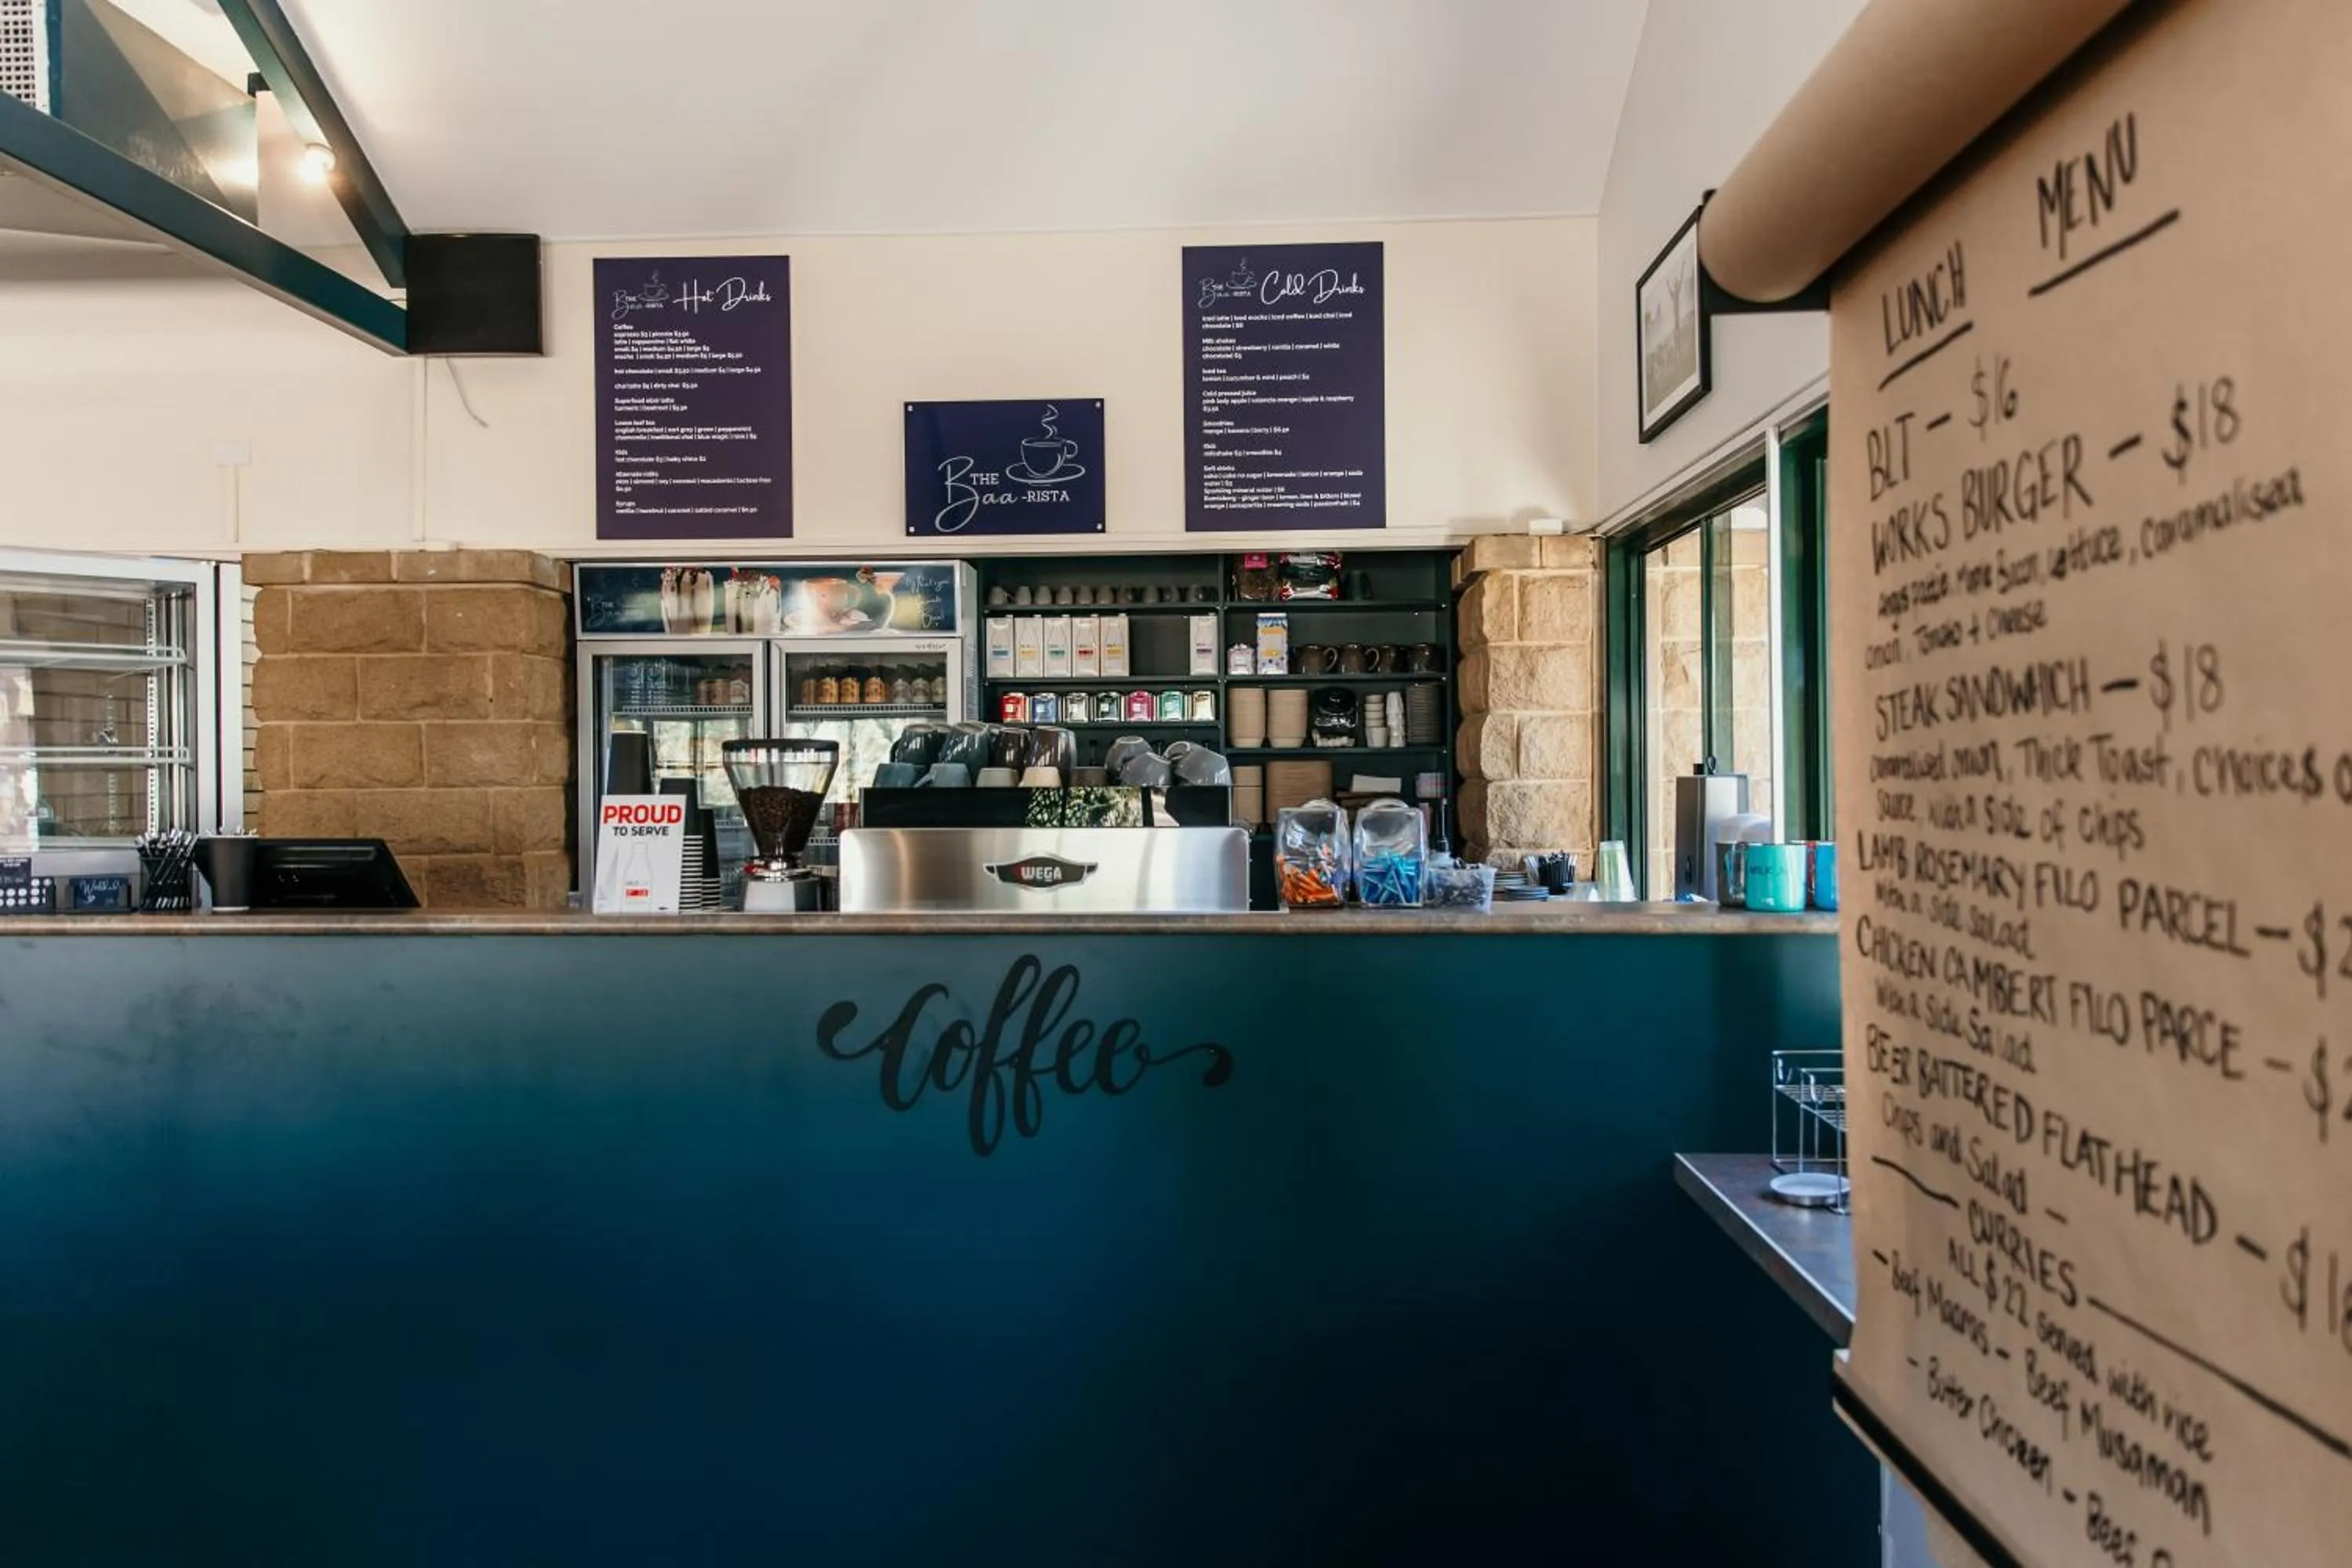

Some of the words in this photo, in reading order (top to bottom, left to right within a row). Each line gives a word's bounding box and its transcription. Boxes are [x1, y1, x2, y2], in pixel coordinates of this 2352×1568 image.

[2036, 111, 2140, 260] MENU
[673, 278, 714, 314] Hot
[716, 277, 771, 311] Drinks
[1261, 270, 1305, 305] Cold
[1308, 269, 1365, 304] Drinks
[1882, 240, 1966, 357] LUNCH
[970, 473, 999, 485] THE
[1867, 413, 1915, 503] BLT
[1871, 492, 1951, 576] WORKS
[1962, 431, 2093, 541] BURGER
[2160, 376, 2241, 486] $18
[1875, 682, 1941, 742] STEAK
[2150, 637, 2225, 734] $18
[603, 804, 682, 824] PROUD
[613, 826, 628, 836] TO
[631, 826, 670, 836] SERVE
[1021, 866, 1062, 881] WEGA
[1857, 829, 1907, 880] LAMB
[1915, 840, 2026, 911] ROSEMARY
[2035, 862, 2101, 913] FILO
[2118, 878, 2251, 958] PARCEL
[1857, 914, 1936, 978] CHICKEN
[2069, 980, 2130, 1047] FILO
[2140, 990, 2247, 1080] PARCE
[1867, 1023, 1911, 1086] BEER
[1918, 1048, 2034, 1145] BATTERED
[2043, 1109, 2218, 1245] FLATHEAD
[1968, 1198, 2078, 1308] CURRIES
